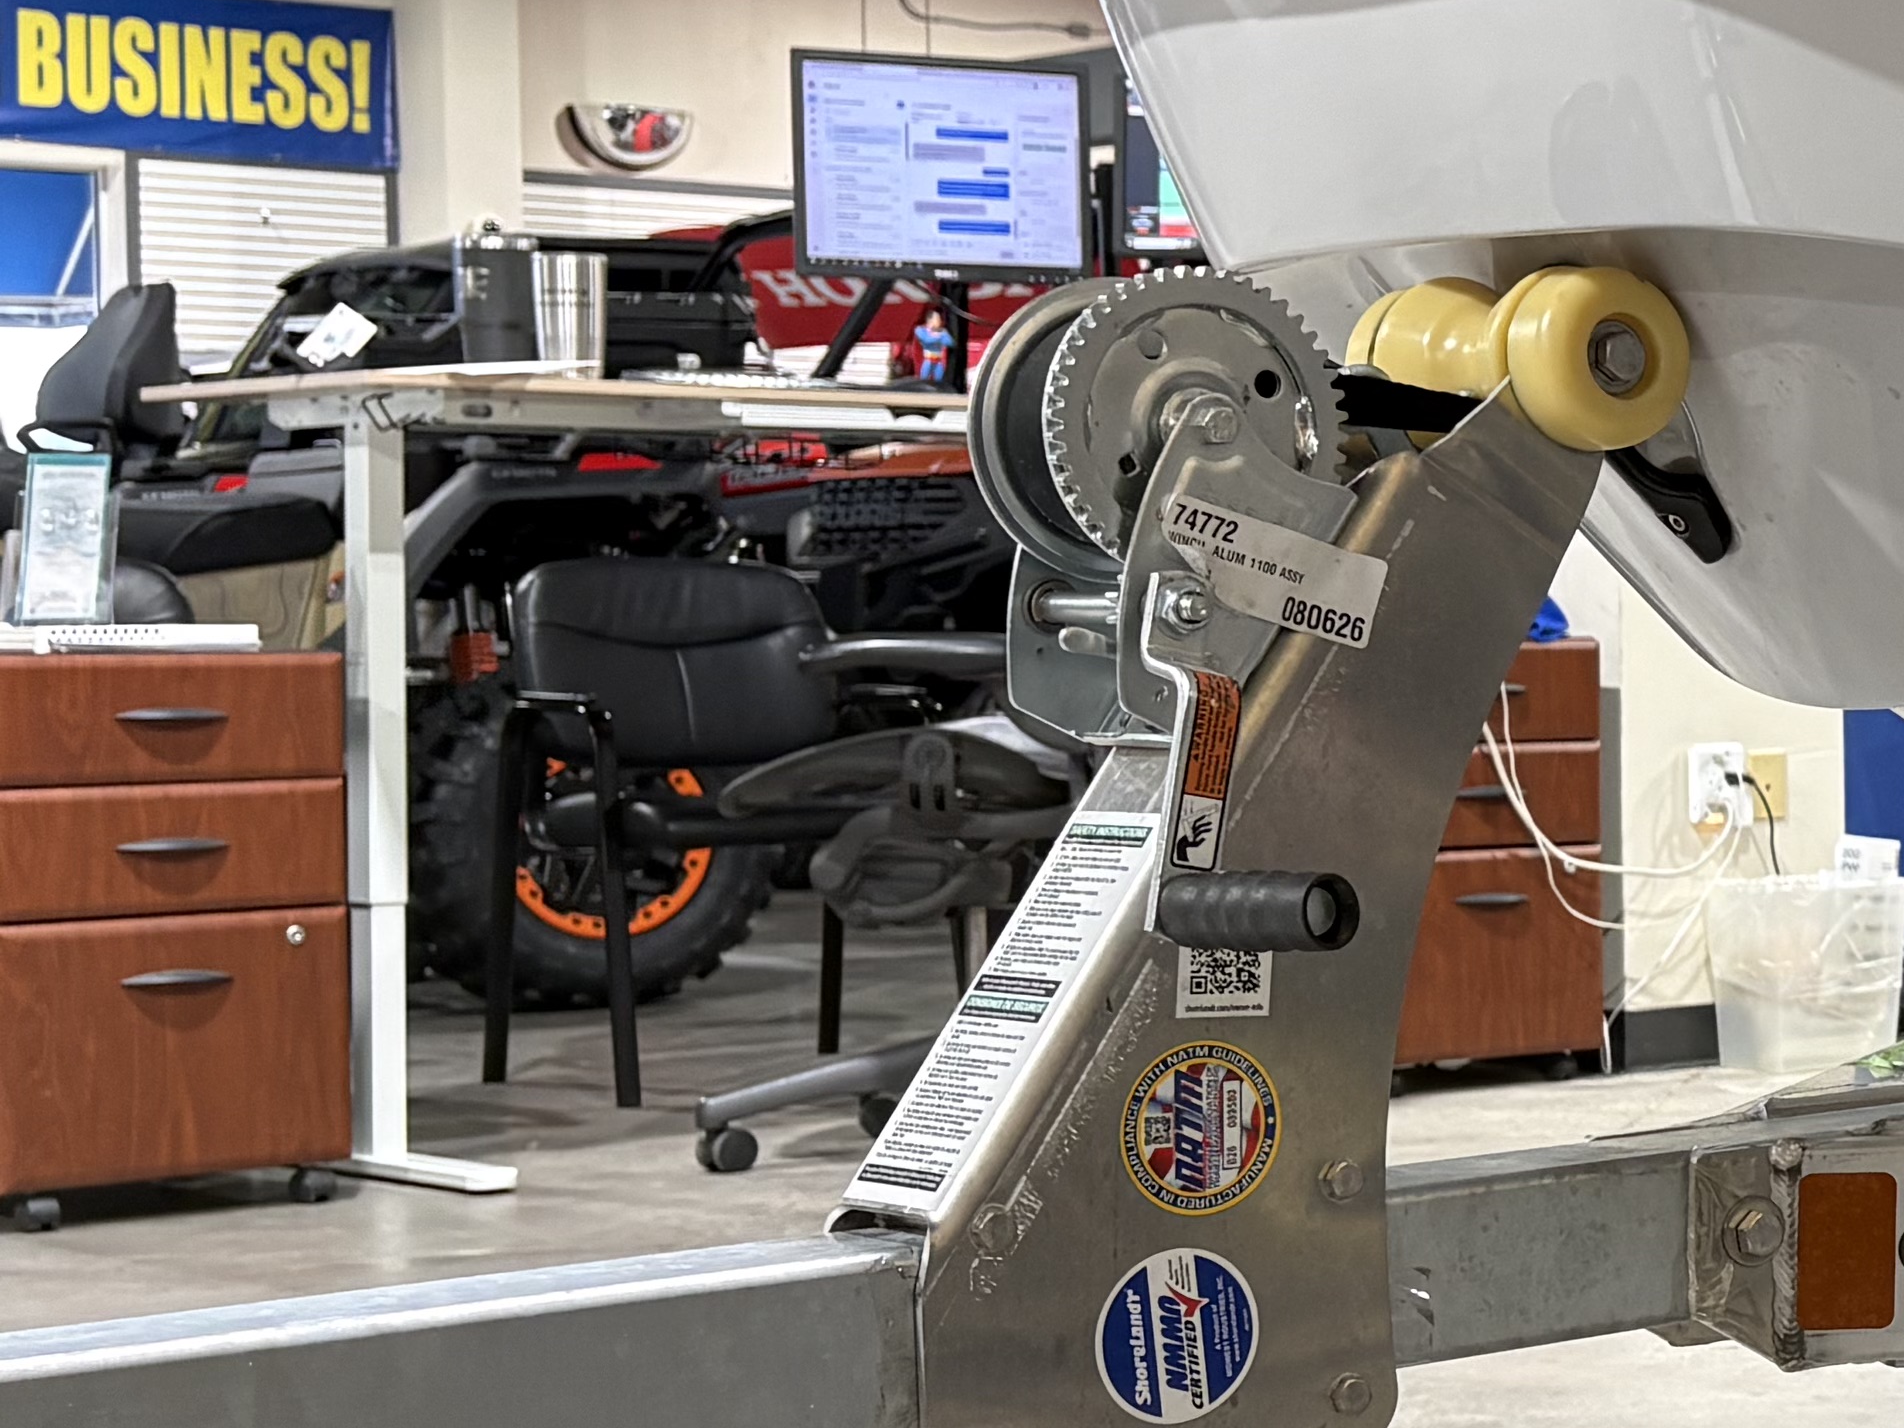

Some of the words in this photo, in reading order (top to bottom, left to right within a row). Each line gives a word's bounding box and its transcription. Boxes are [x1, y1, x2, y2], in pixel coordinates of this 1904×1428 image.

[16, 7, 372, 134] BUSINESS!
[1171, 503, 1240, 544] 74772
[1212, 545, 1246, 566] ALUM
[1250, 557, 1278, 576] 1100
[1279, 567, 1306, 585] ASSY
[1281, 596, 1366, 642] 080626
[1137, 1062, 1167, 1097] WITH
[1167, 1045, 1209, 1066] NATM
[1212, 1047, 1274, 1107] GUIDELINES
[1125, 1098, 1160, 1195] COMPLIANCE
[1174, 1069, 1206, 1192] NATM
[1160, 1189, 1177, 1204] IN
[1177, 1138, 1274, 1210] MANUFACTURED
[1157, 1295, 1189, 1392] NMMA
[1183, 1320, 1204, 1410] CERTIFIED
